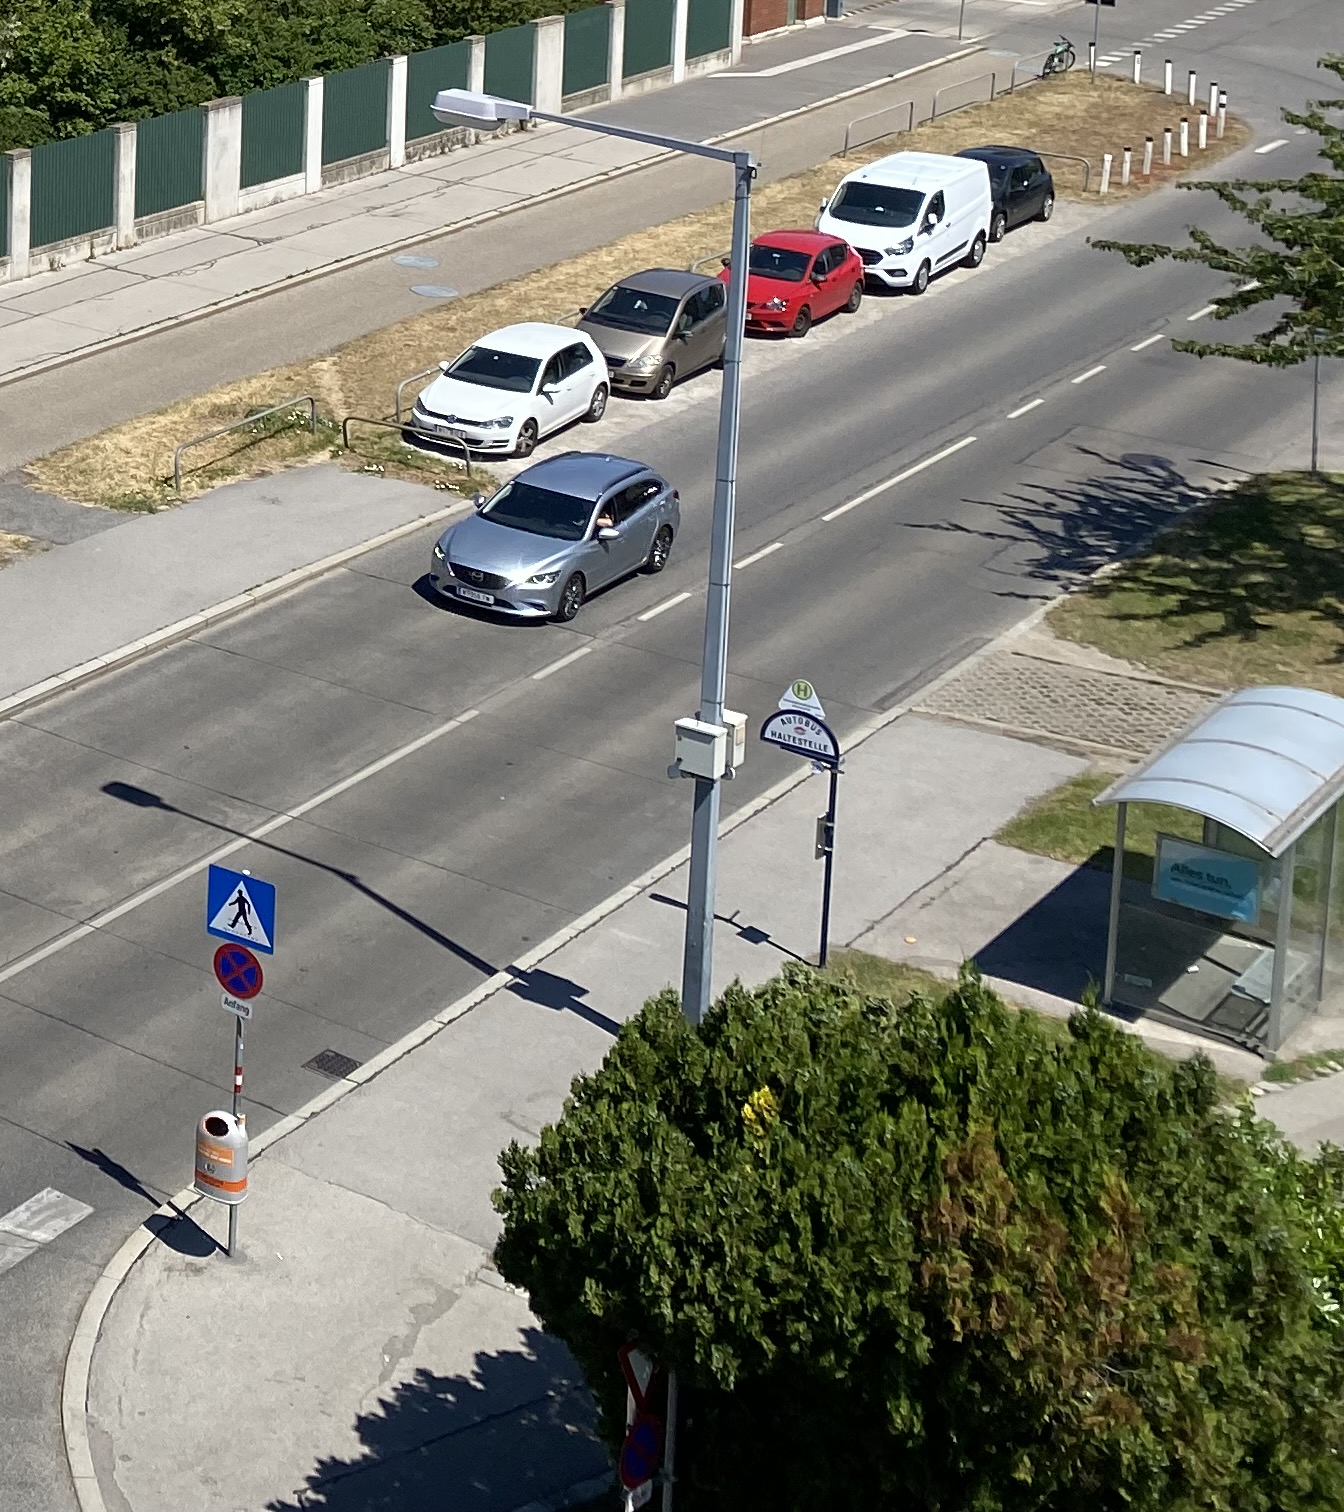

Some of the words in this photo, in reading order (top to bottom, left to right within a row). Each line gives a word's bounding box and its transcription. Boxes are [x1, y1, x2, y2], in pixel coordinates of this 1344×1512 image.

[797, 683, 808, 697] H
[780, 715, 823, 736] AUTOBUS
[770, 730, 829, 752] HALTESTELLE
[223, 996, 250, 1017] Anfang
